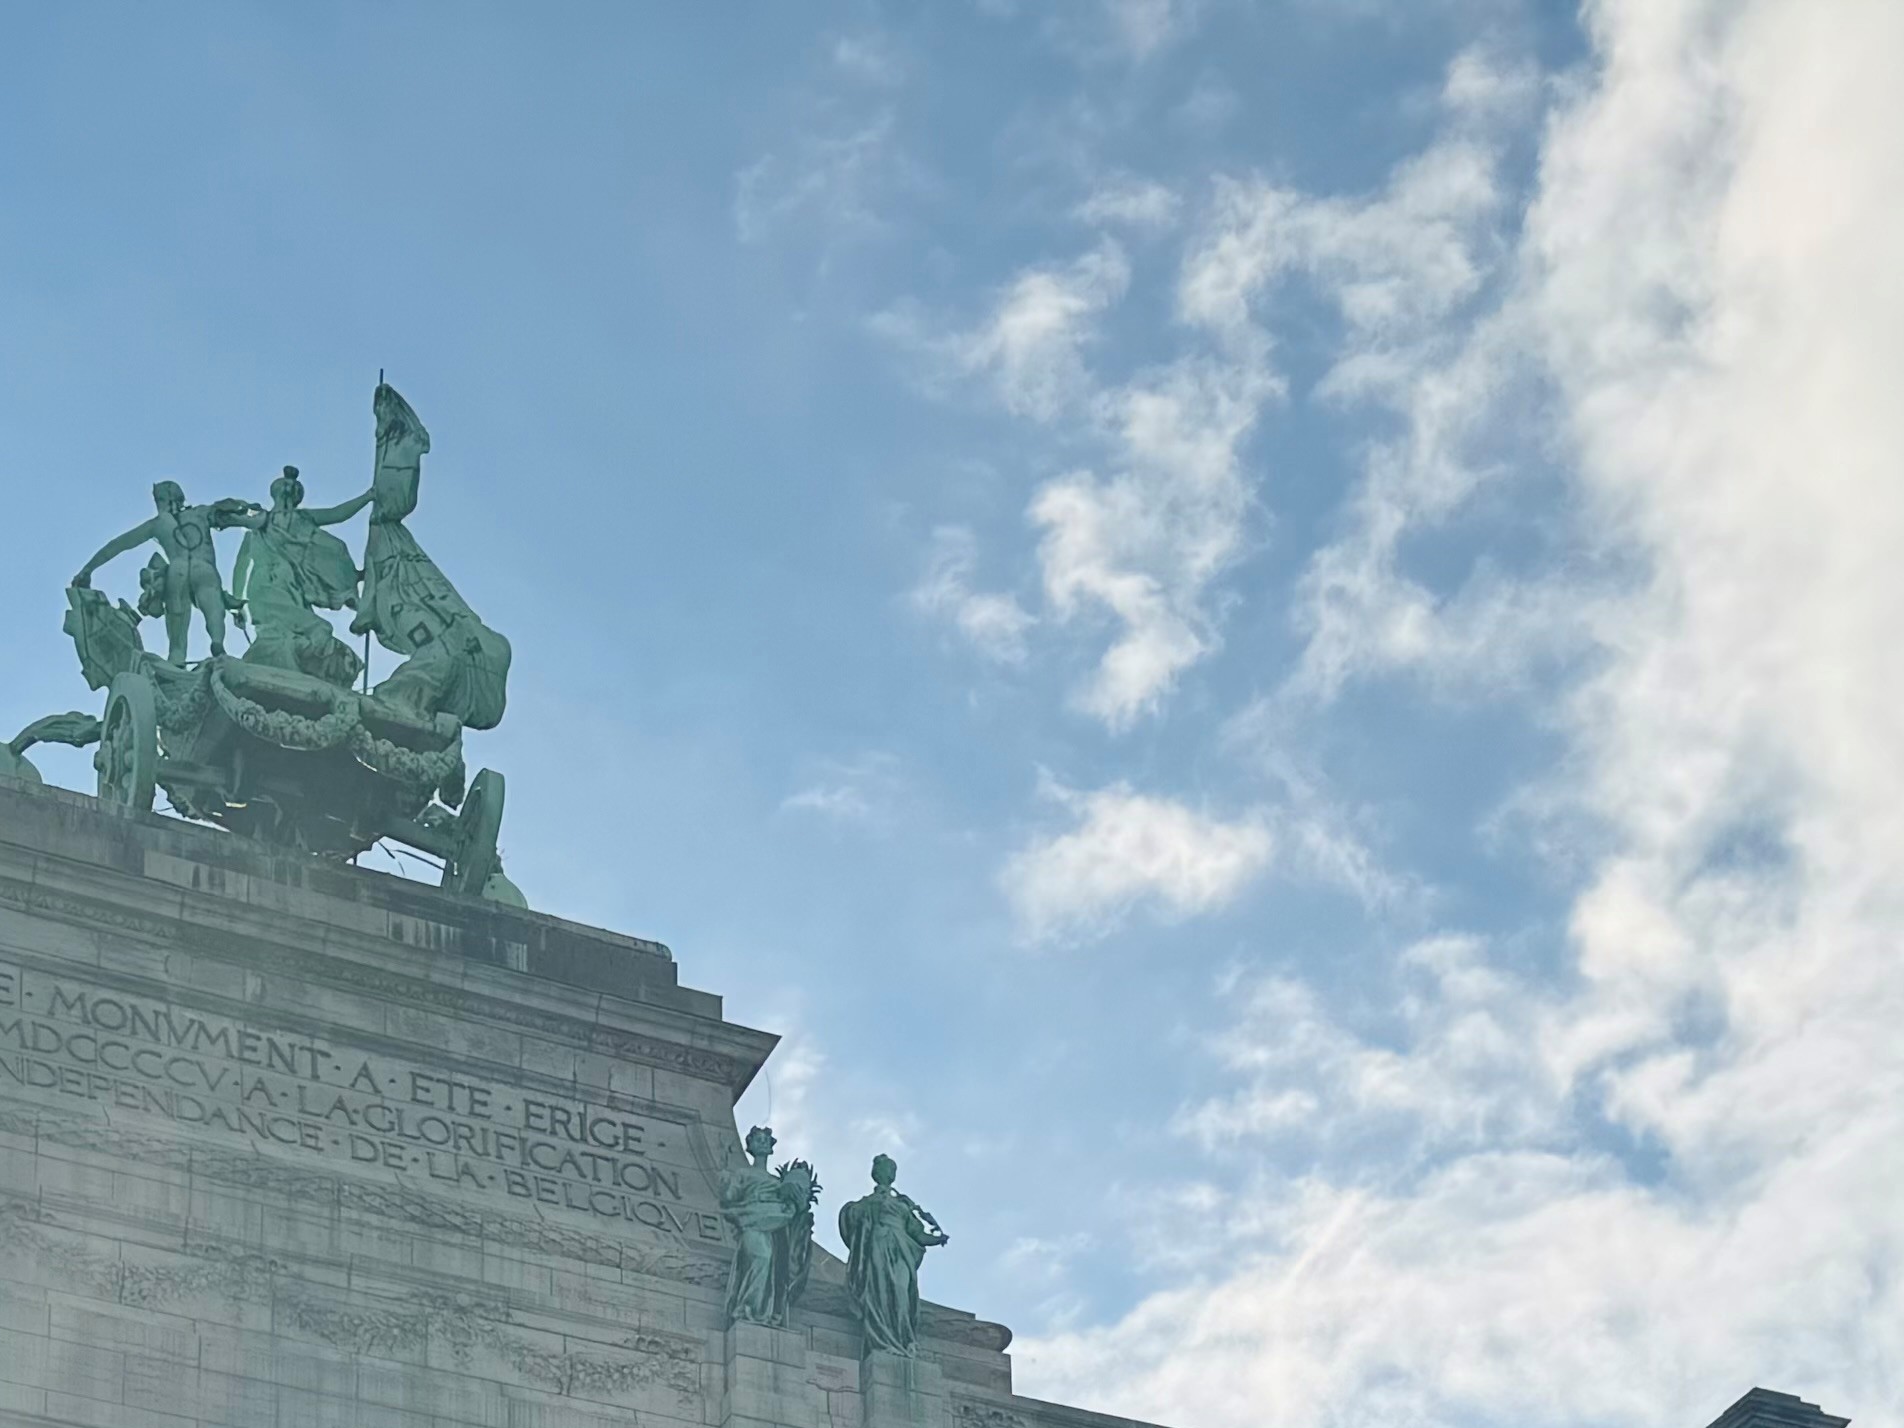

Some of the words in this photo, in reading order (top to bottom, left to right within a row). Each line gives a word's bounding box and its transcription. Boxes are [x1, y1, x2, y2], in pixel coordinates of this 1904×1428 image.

[47, 984, 332, 1081] MONVMENT
[351, 1060, 383, 1094] A
[409, 1071, 493, 1120] ETE
[522, 1098, 646, 1154] ERIGE
[243, 1077, 278, 1107] A
[297, 1085, 355, 1126] LA
[362, 1103, 684, 1201] GLORIFICATION
[350, 1133, 407, 1172] DE
[427, 1151, 487, 1190] LA
